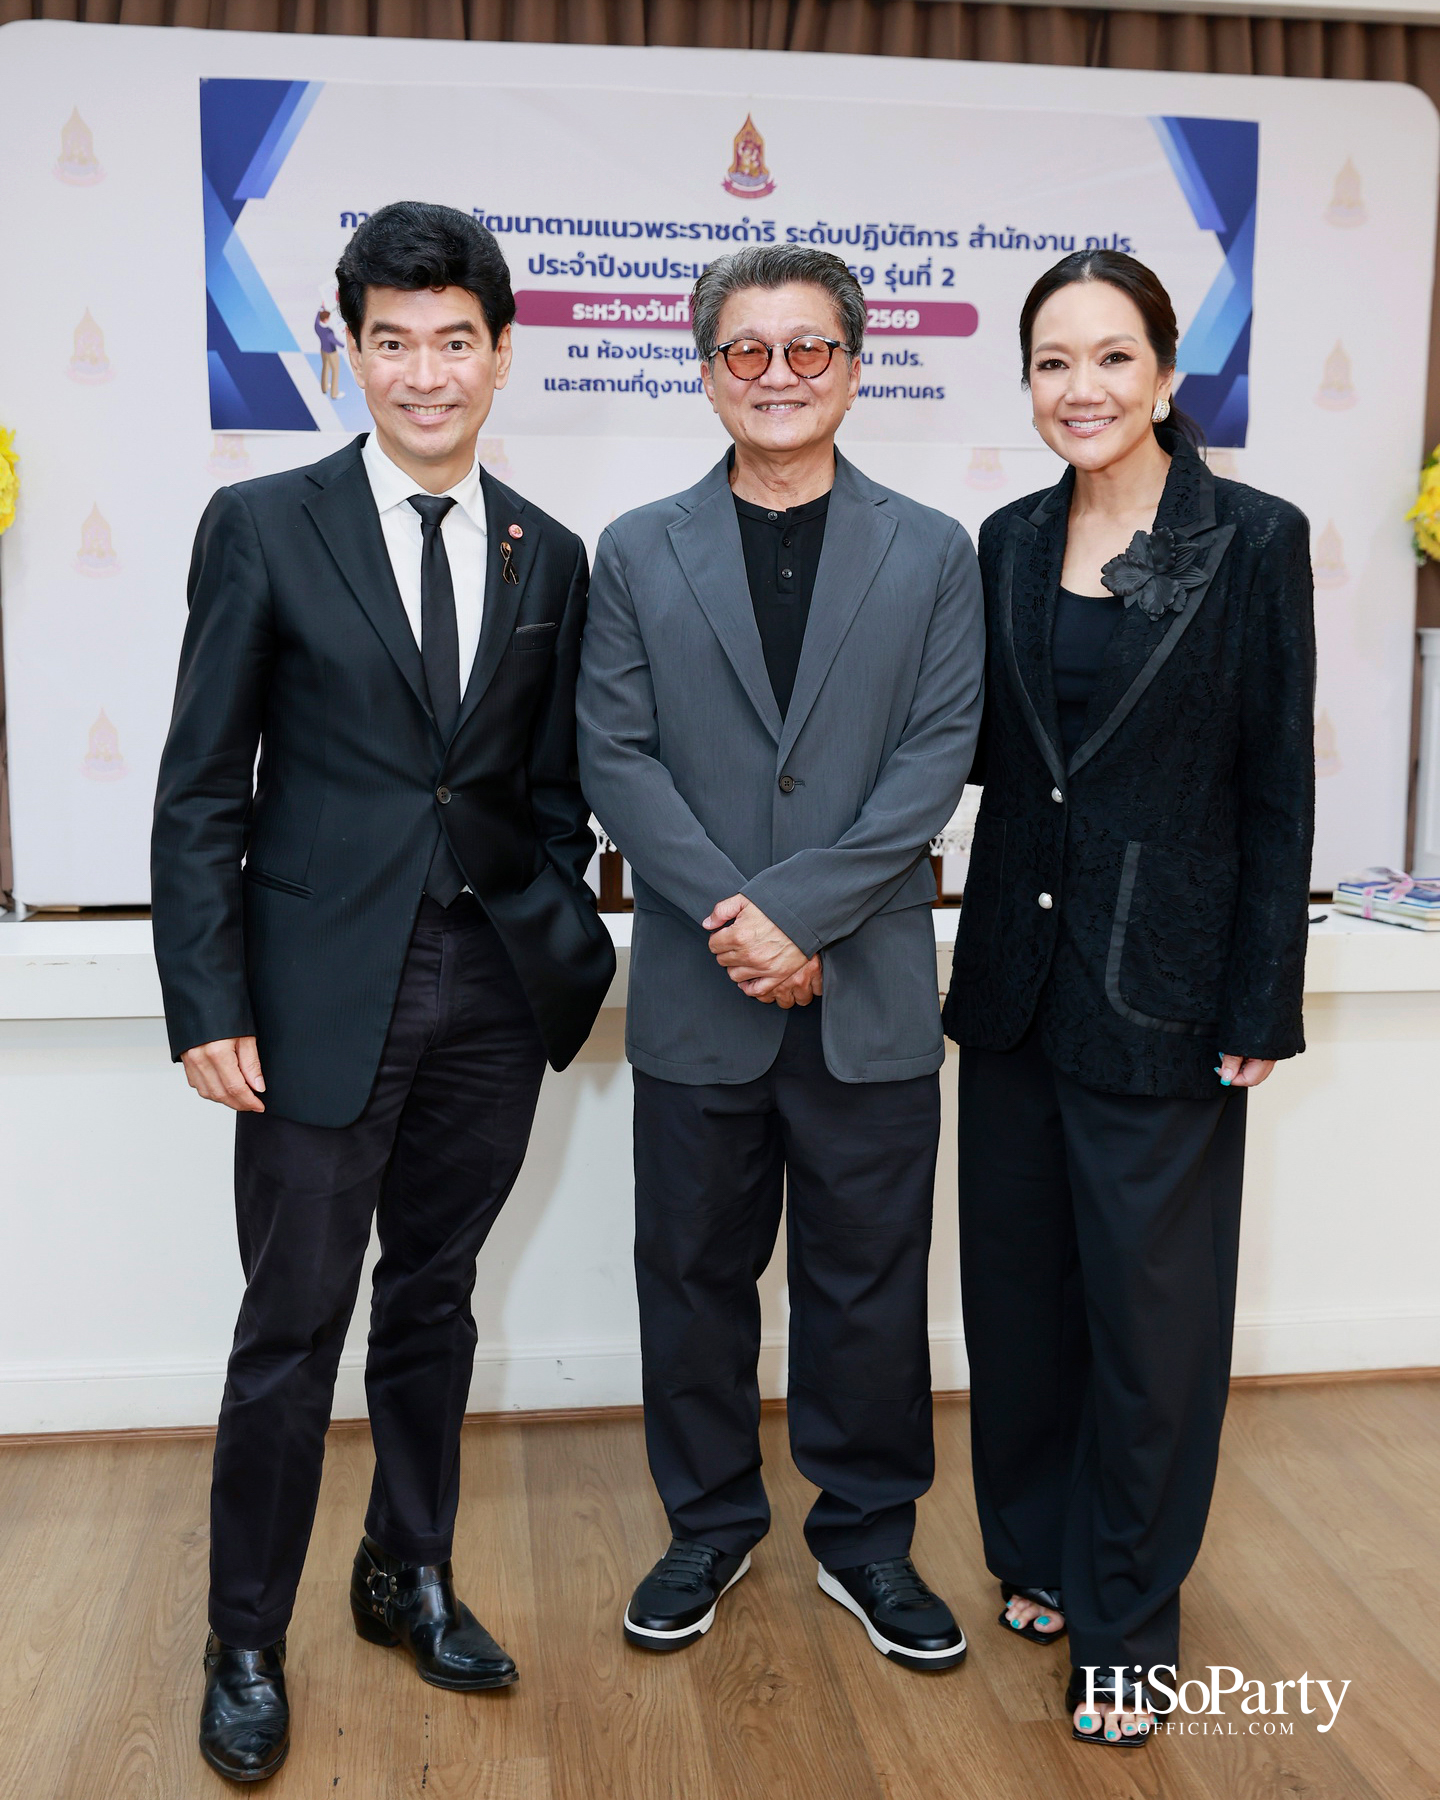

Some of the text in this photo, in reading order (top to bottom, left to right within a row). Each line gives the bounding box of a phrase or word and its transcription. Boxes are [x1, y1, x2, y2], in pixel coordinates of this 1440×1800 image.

[786, 220, 958, 251] ระดับปฏิบัติการ
[968, 222, 1075, 252] สำนักงาน
[528, 251, 708, 279] ประจำปีงบประม
[885, 257, 932, 293] รุ่นที่
[942, 267, 955, 287] 2
[572, 294, 920, 329] ระหว่างวันที่ 2569
[568, 344, 588, 359] ณ
[597, 339, 697, 366] ห้องประชุม
[882, 349, 924, 367] กปร.
[544, 368, 945, 400] และสถานที่ดูงานใ พมหานคร
